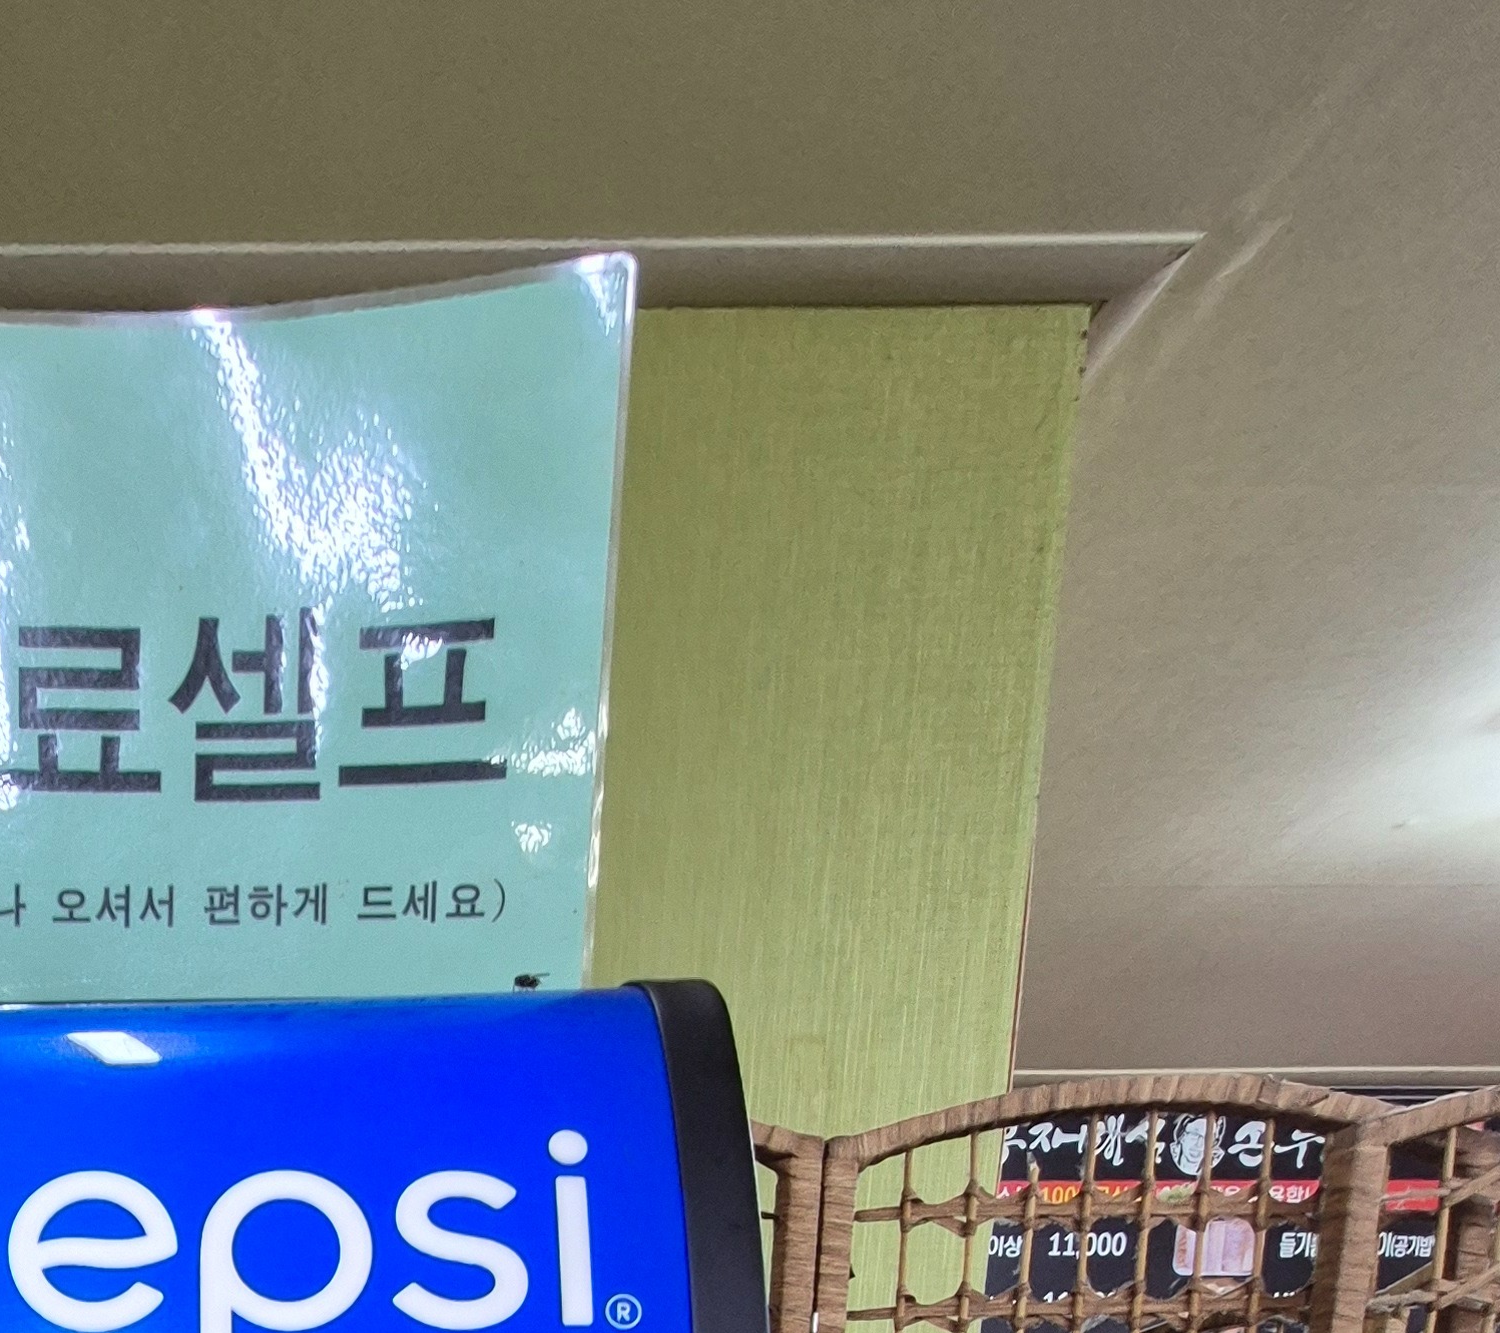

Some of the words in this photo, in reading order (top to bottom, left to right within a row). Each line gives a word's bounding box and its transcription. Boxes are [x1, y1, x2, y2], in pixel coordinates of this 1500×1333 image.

[52, 885, 178, 929] 오셔서
[203, 881, 331, 927] 편하게
[356, 877, 509, 928] 드세요)
[1048, 1231, 1128, 1259] 11,000
